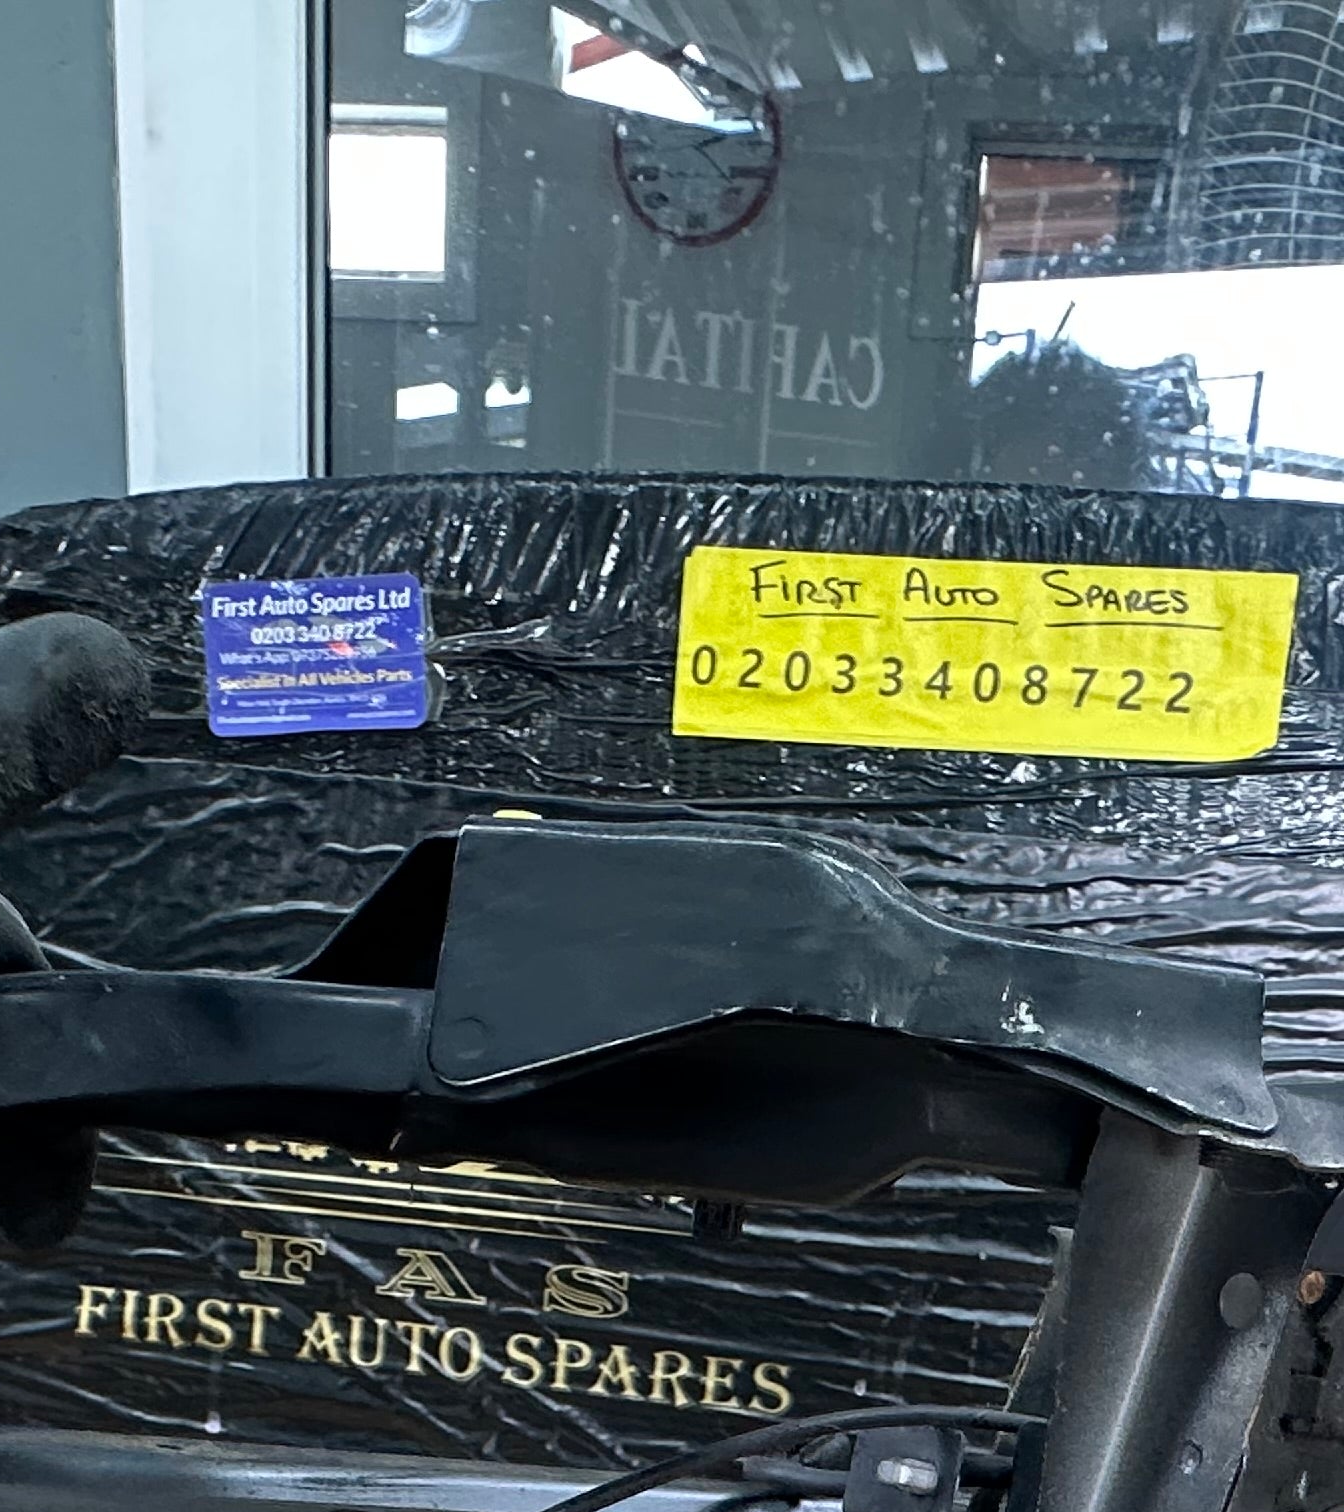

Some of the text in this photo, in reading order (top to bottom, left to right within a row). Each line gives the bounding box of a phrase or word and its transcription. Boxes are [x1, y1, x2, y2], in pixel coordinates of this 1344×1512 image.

[211, 587, 411, 618] First Auto Spares Ltd
[902, 567, 999, 606] AUTO
[1041, 569, 1190, 613] SPARES
[250, 626, 295, 645] 0203
[691, 644, 1196, 714] 02033408722
[74, 1284, 794, 1415] FIRST AUTO SPARES
